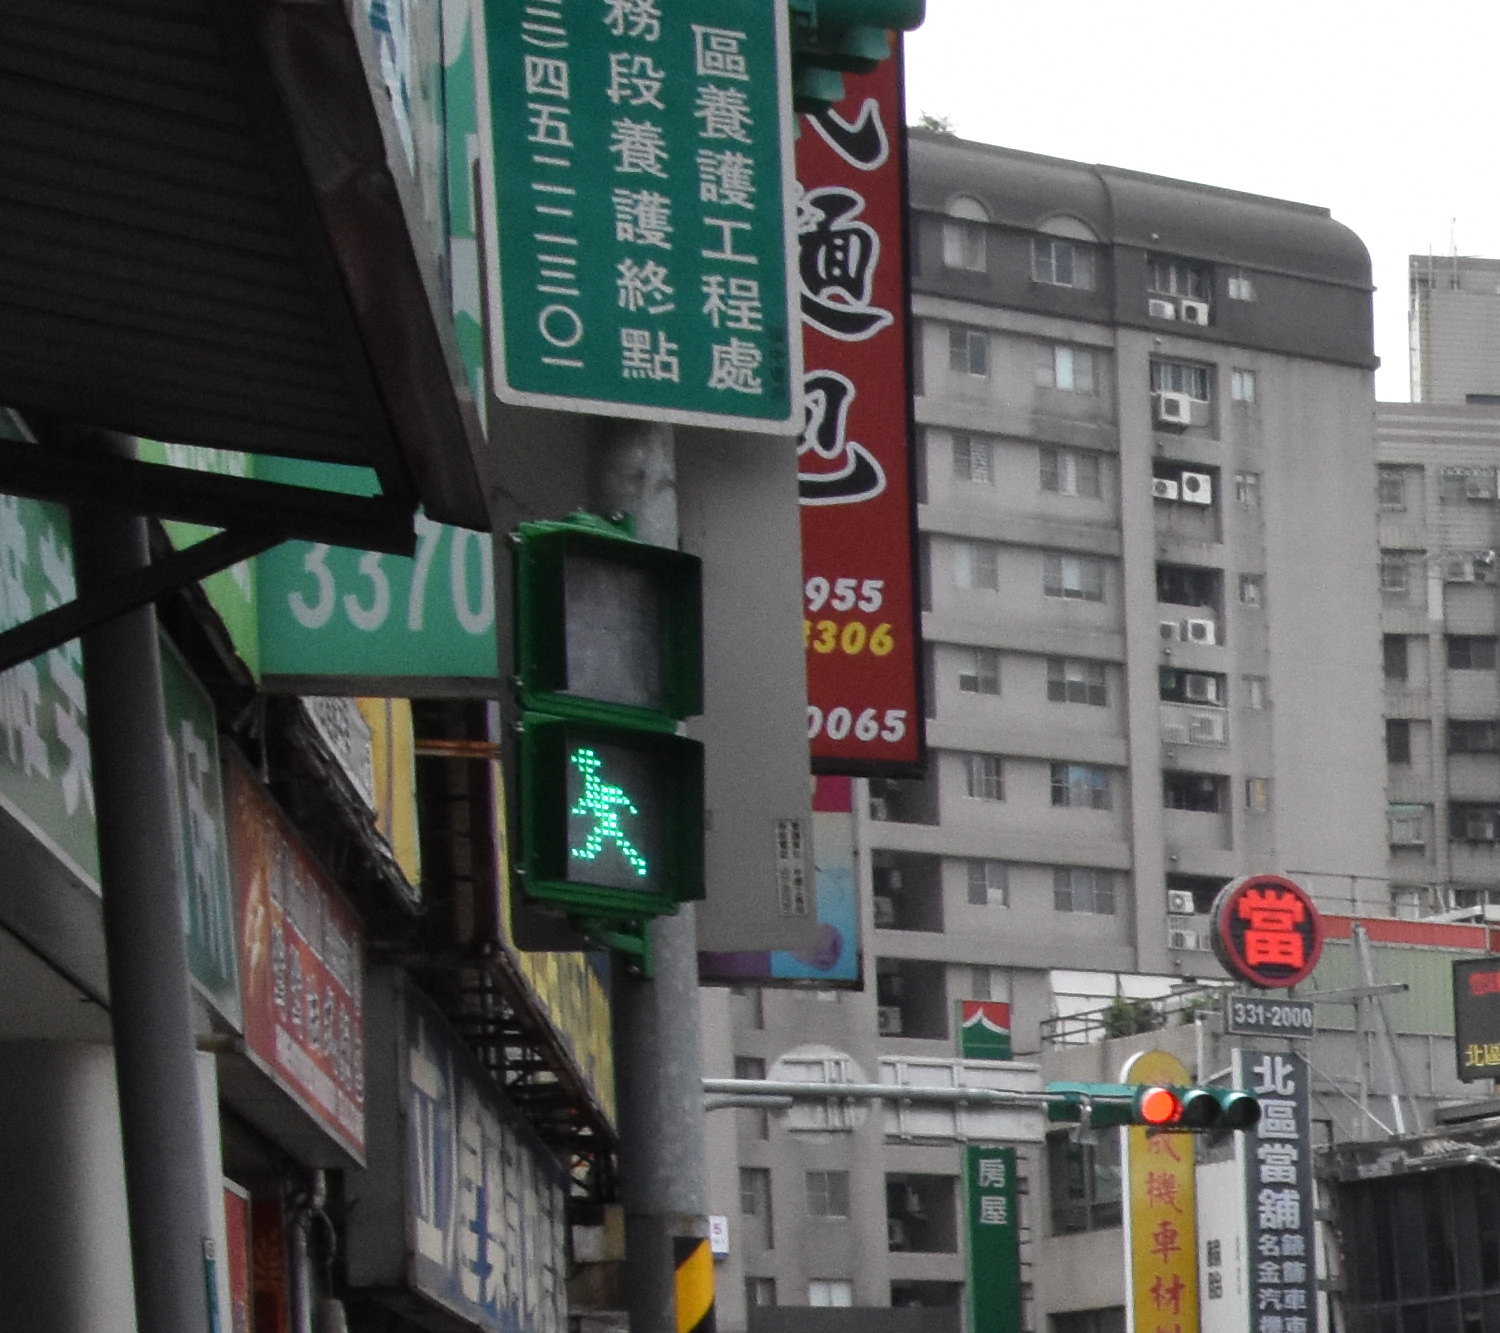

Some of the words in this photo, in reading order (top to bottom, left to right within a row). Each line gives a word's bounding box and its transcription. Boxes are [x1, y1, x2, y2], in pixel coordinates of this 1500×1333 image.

[604, 0, 680, 383] 務段養護終點
[691, 23, 763, 395] 區養護工程處
[1233, 1002, 1313, 1030] 331-2000
[1238, 889, 1307, 969] 當
[1252, 1055, 1301, 1233] 北區當舖
